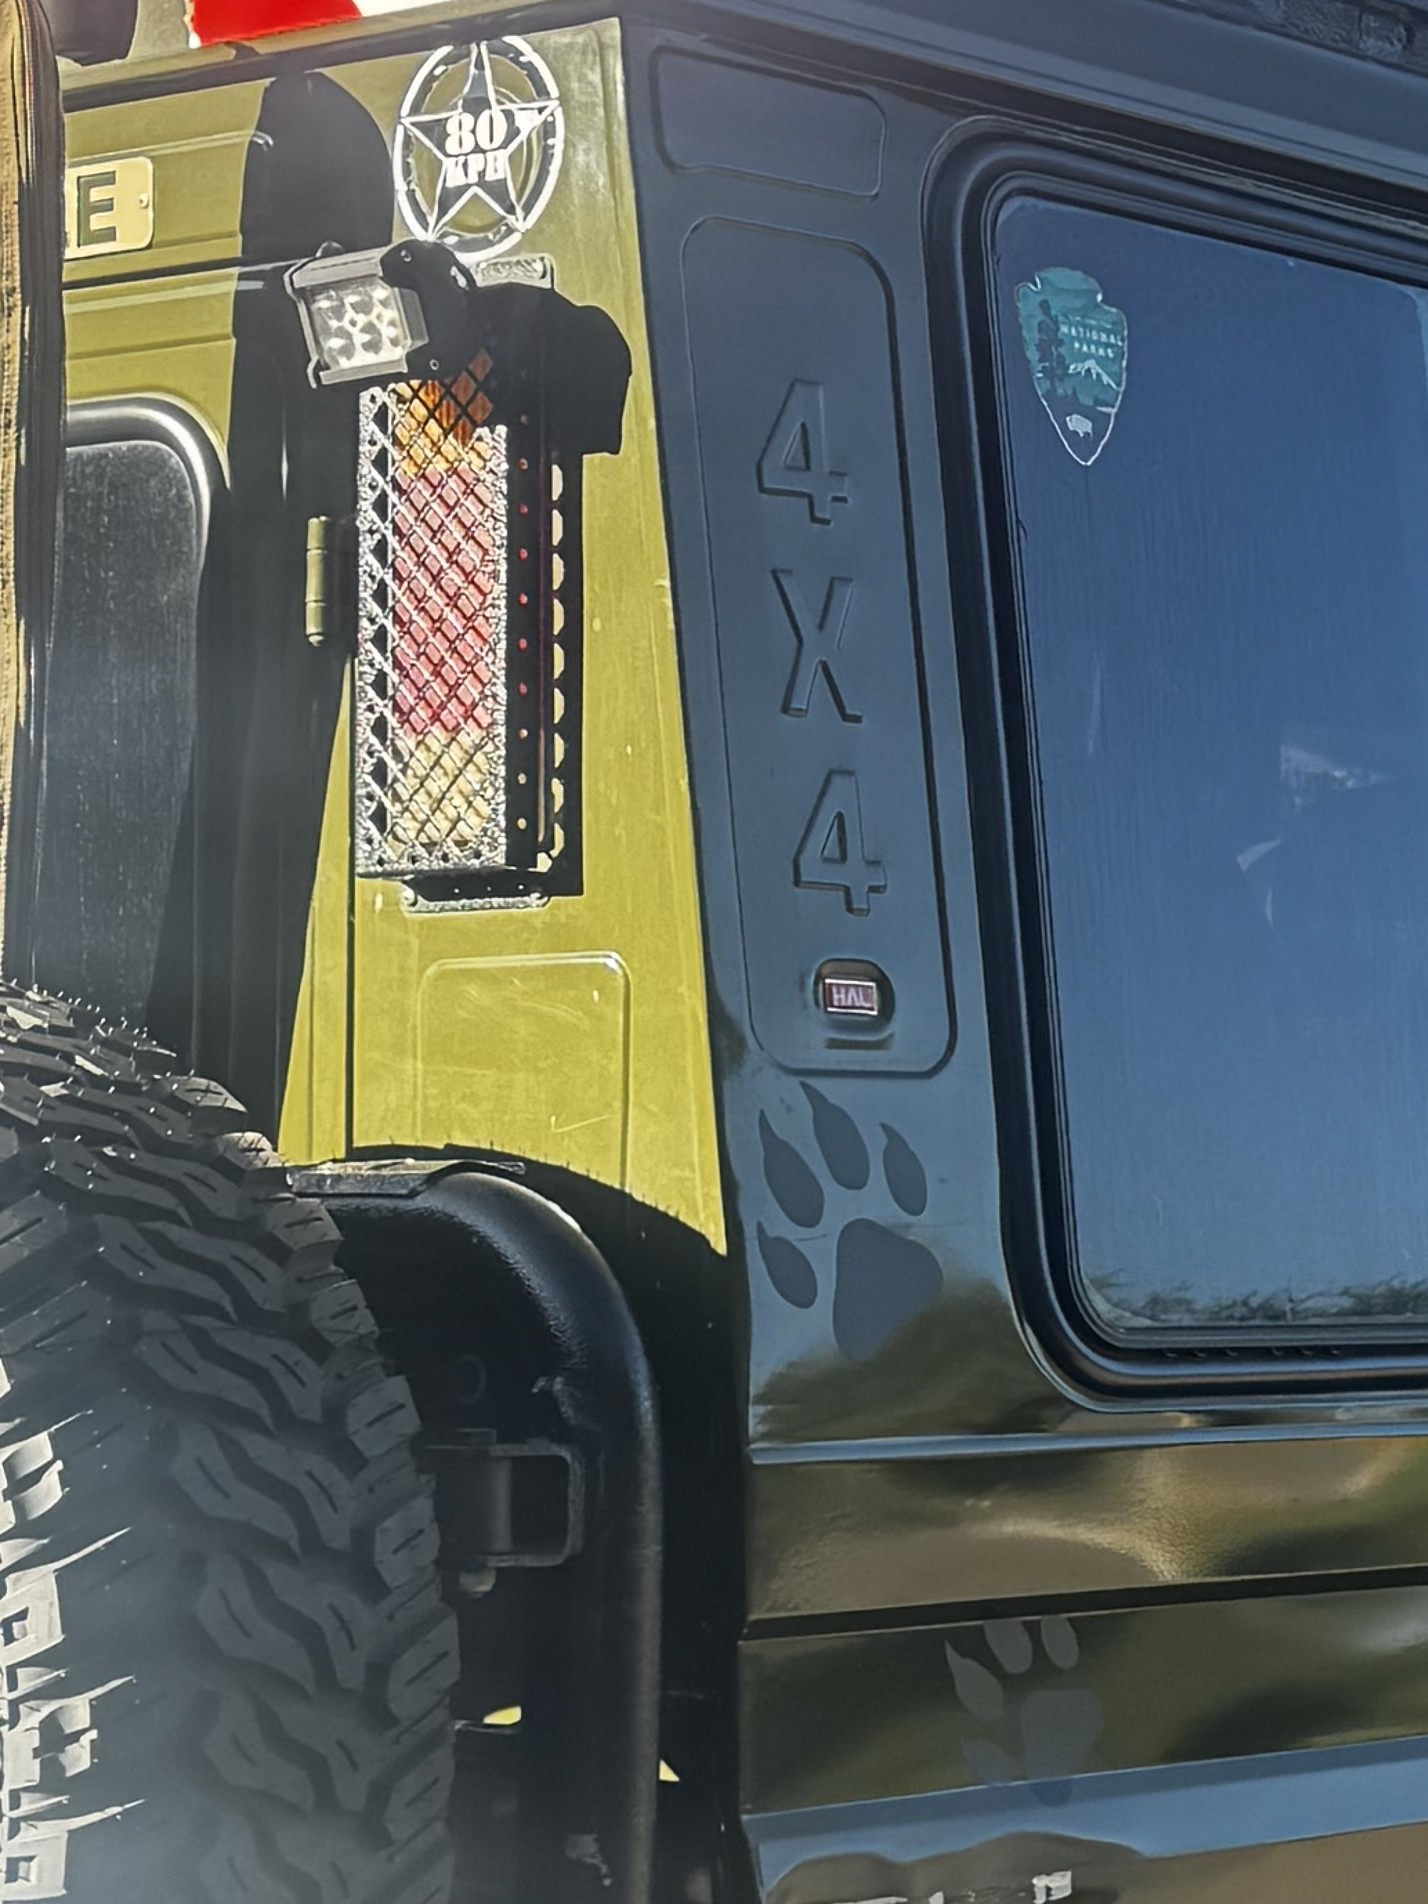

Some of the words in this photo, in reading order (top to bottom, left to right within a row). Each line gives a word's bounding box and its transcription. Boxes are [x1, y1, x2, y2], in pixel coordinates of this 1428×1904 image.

[445, 109, 507, 156] 80
[445, 149, 507, 188] KPH
[1059, 324, 1123, 346] NATIONAL
